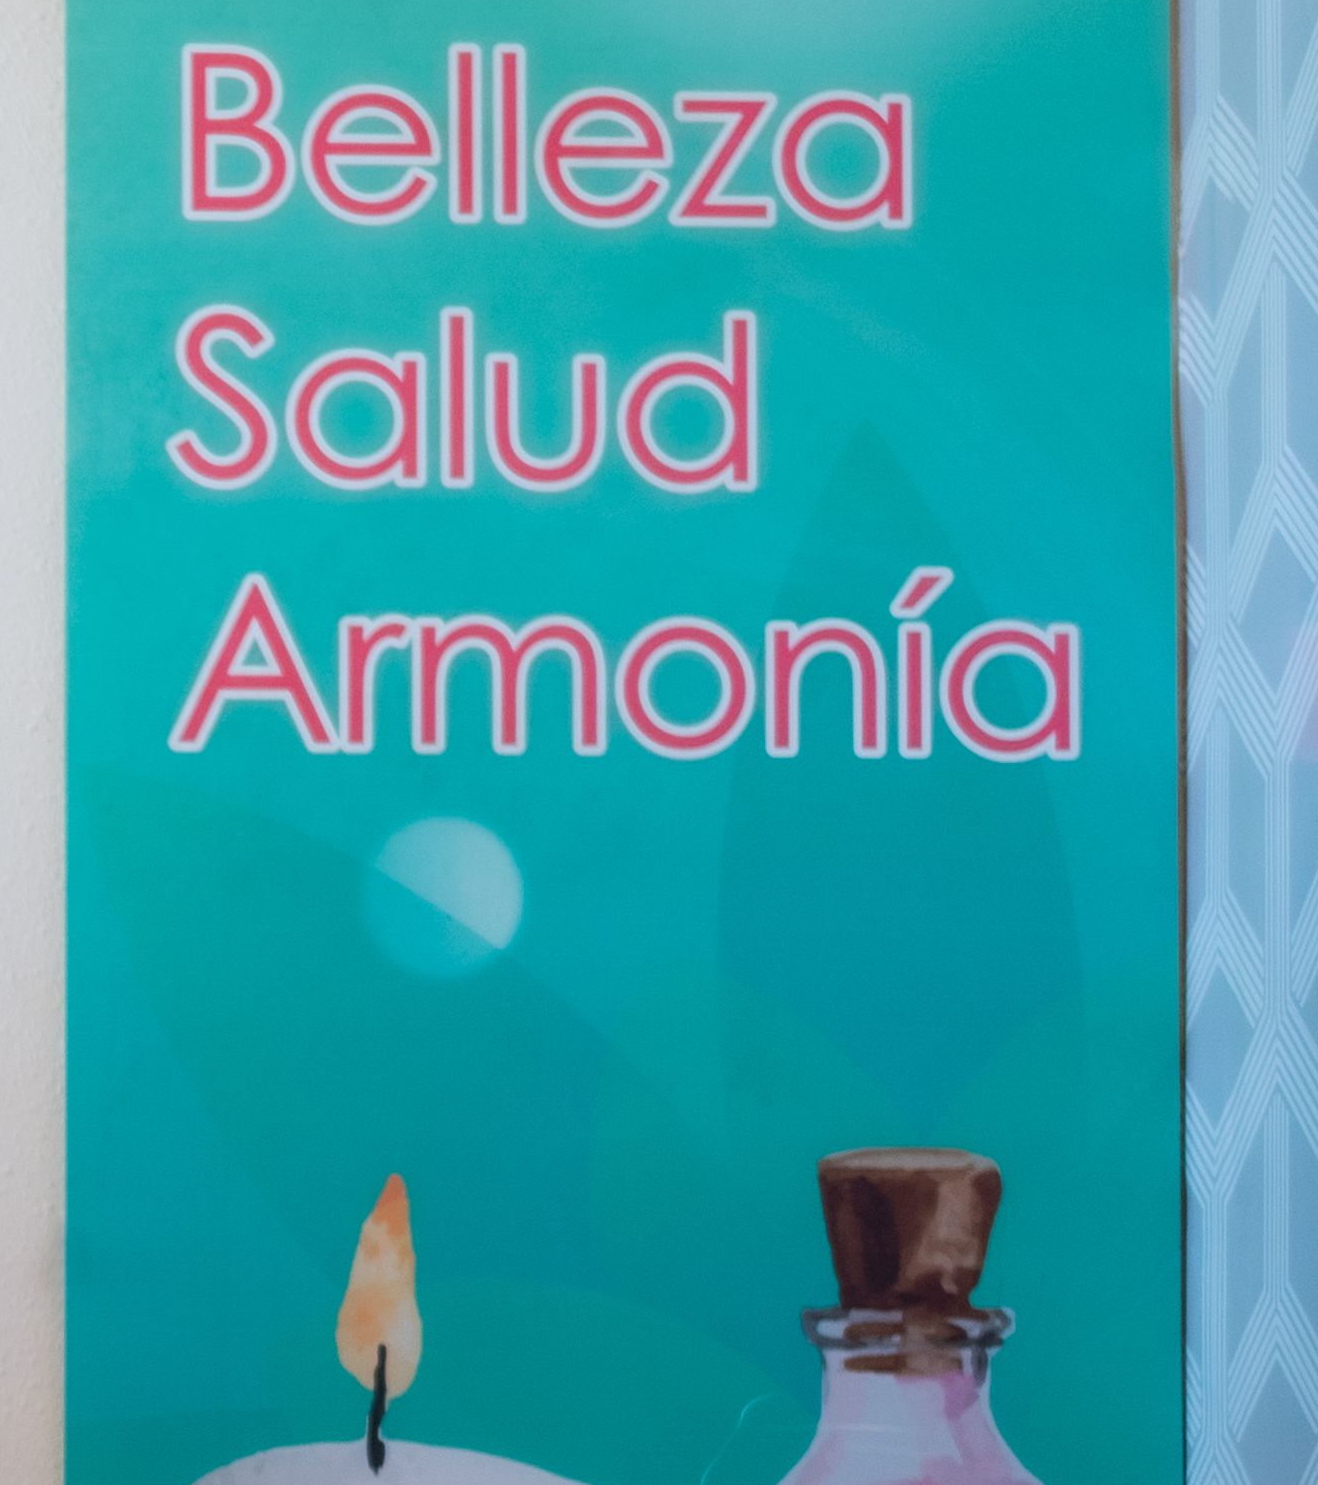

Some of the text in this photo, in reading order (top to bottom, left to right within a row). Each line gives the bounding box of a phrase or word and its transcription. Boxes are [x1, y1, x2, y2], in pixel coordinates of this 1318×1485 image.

[184, 46, 908, 228] Belleza
[169, 309, 755, 489] Salud
[171, 570, 1078, 759] Armonía
